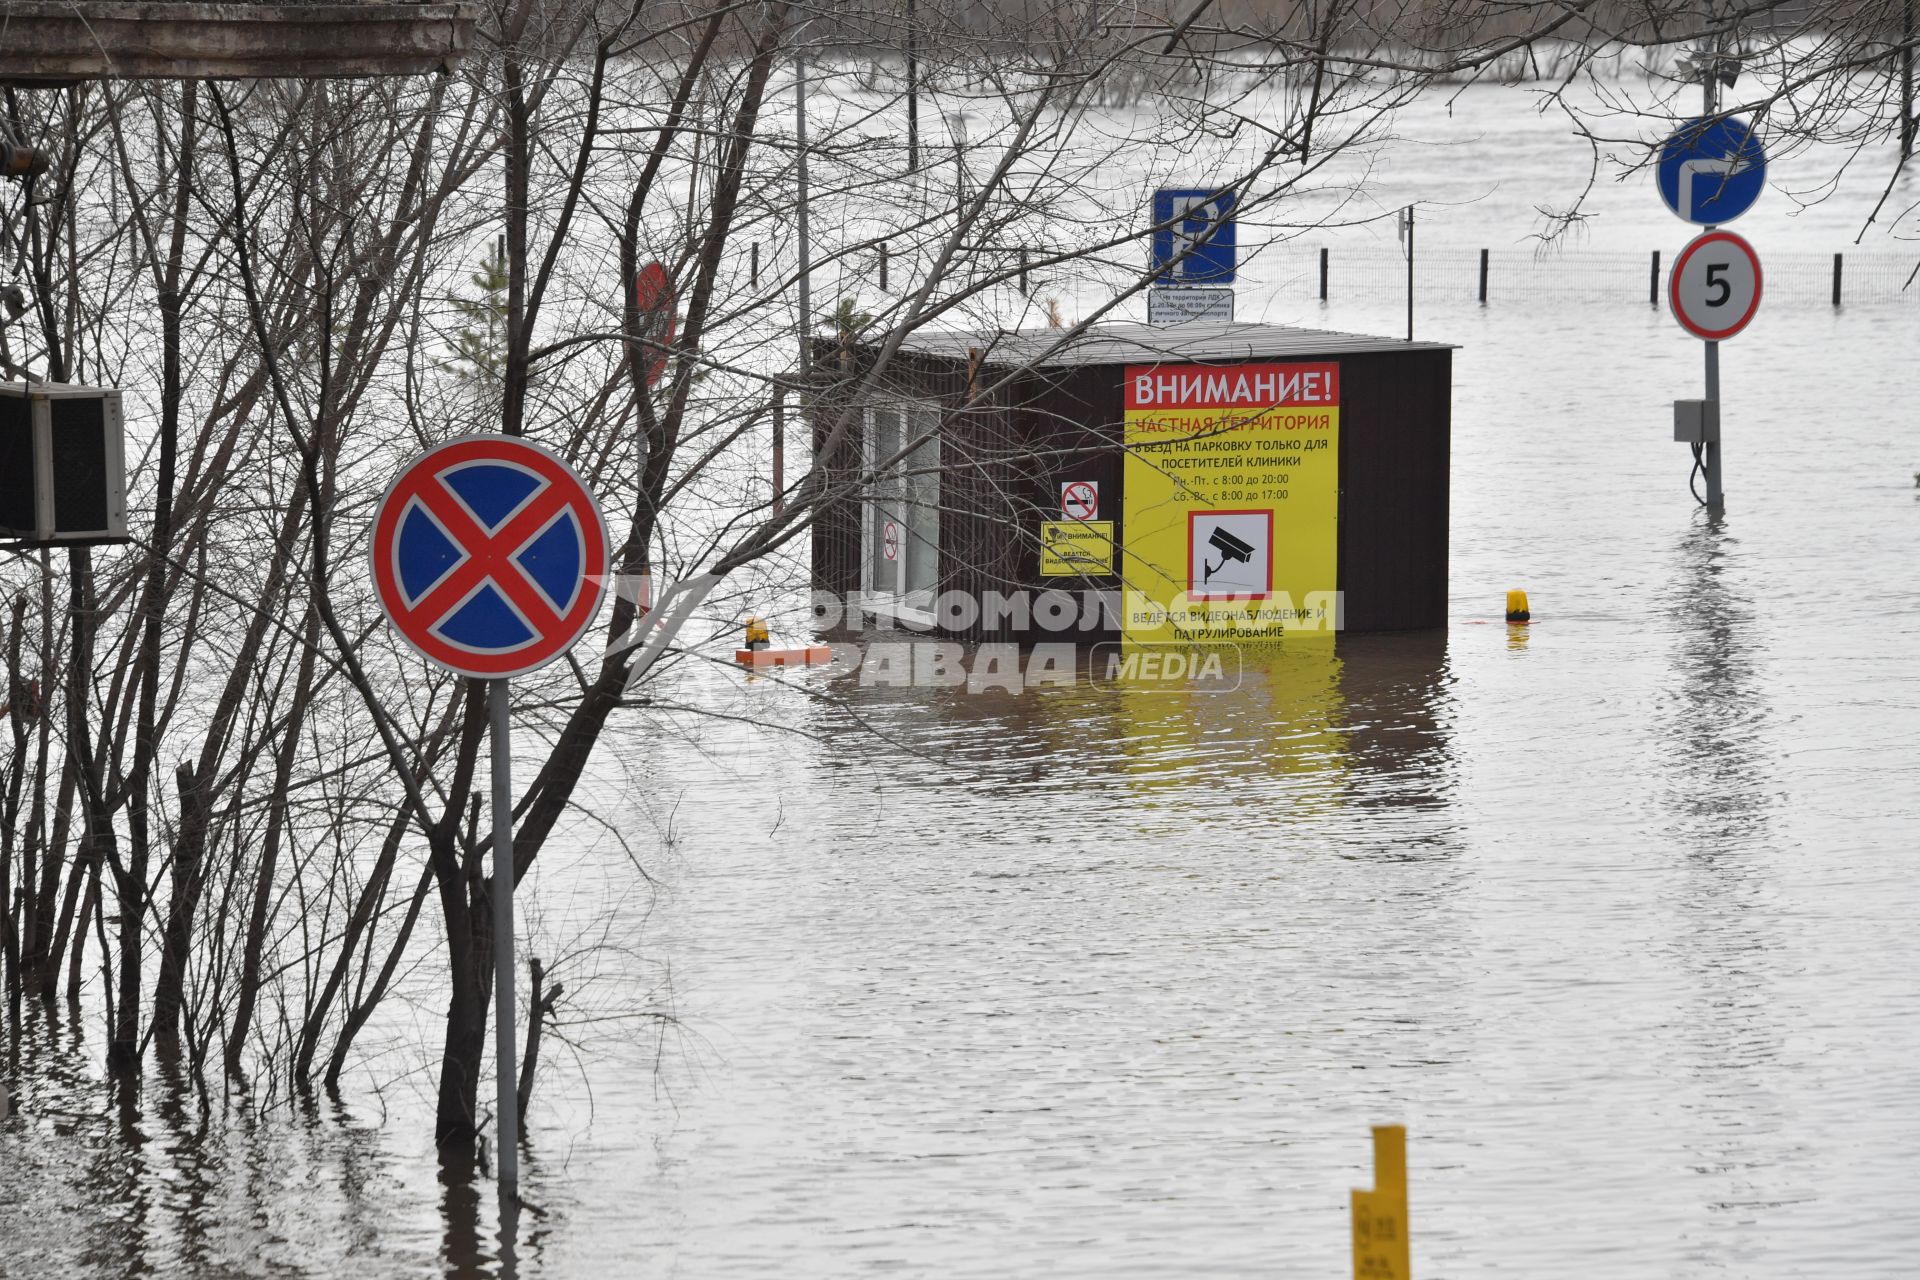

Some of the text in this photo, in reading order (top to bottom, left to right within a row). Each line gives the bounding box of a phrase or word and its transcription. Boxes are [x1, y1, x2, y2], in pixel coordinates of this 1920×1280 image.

[1172, 196, 1219, 277] P
[1705, 263, 1731, 307] 5
[1135, 371, 1332, 404] ВНИМАНИЕ!
[1135, 414, 1329, 433] ЧАСТНАЯ ТЕРРИТОРИЯ
[1175, 442, 1190, 452] НА
[1194, 441, 1252, 452] ПАРКОВКУ
[1255, 440, 1301, 451] ТОЛЬКО
[1304, 439, 1328, 452] ДЛЯ
[1161, 455, 1301, 469] ПОСЕТИТЕЛЕЙ КЛИНИКИ
[1222, 475, 1243, 485] 8:00
[1246, 477, 1259, 486] до
[1262, 474, 1289, 484] 20:00
[1213, 493, 1218, 501] с
[1221, 490, 1243, 500] 8:00
[1245, 492, 1258, 502] до
[1262, 490, 1289, 500] 17:00
[1190, 609, 1313, 623] ВИДЕОНАБЛЮДЕНИЕ
[1316, 608, 1326, 619] И
[1174, 626, 1284, 639] ПАТРУЛИРОВАНИЕ
